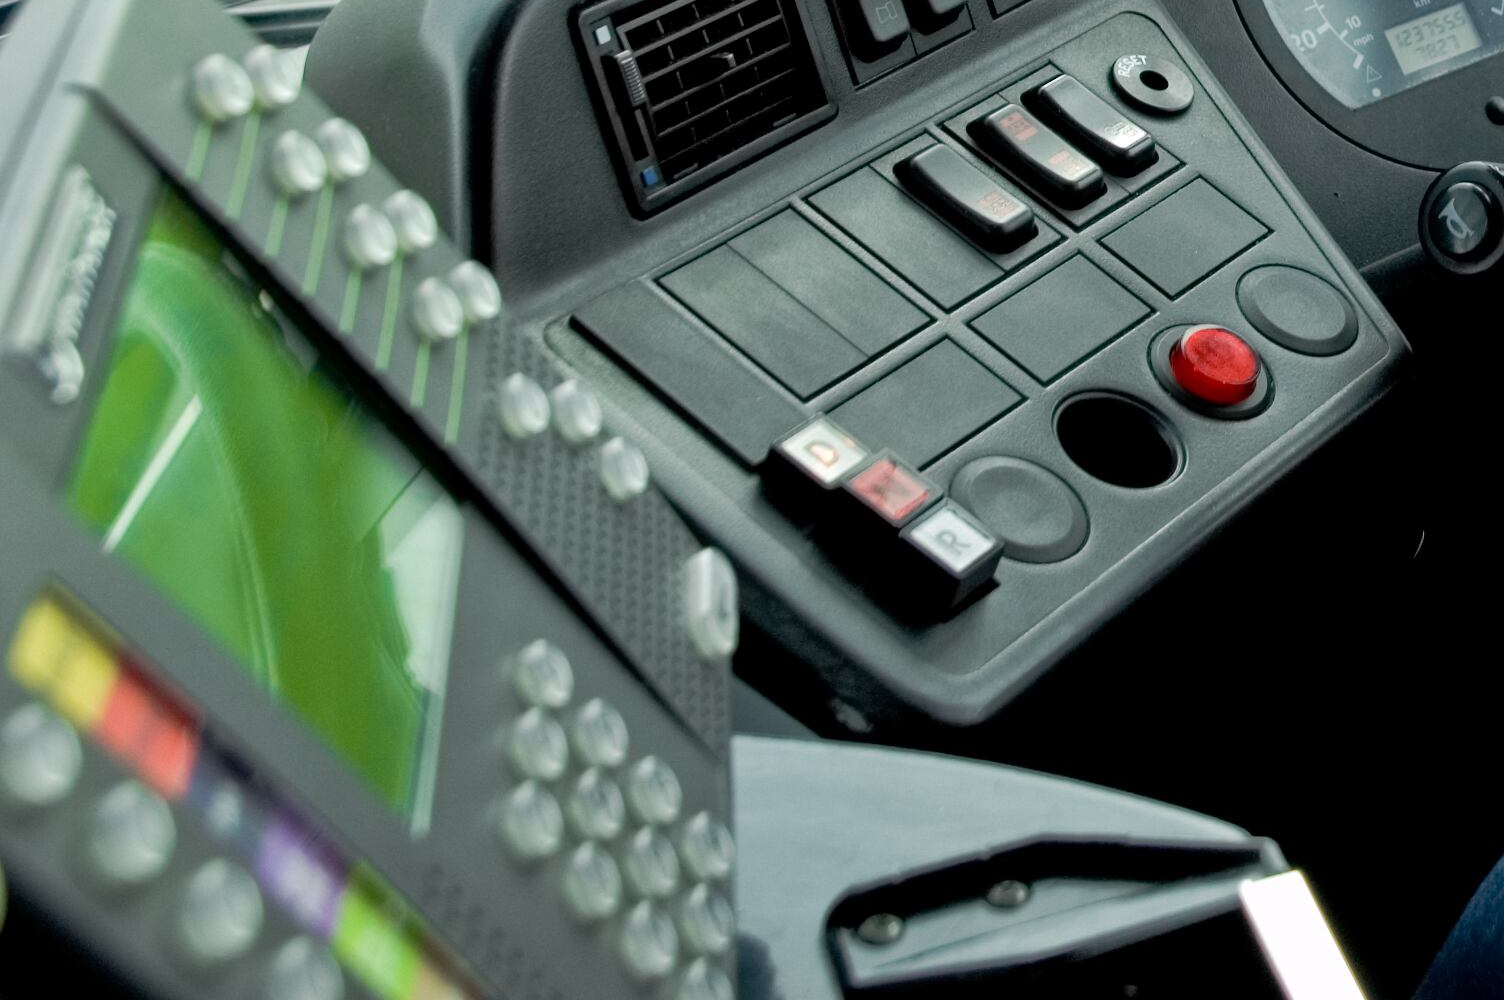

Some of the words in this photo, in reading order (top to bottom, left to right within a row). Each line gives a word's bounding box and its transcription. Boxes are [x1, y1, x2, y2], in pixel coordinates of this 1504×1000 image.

[1345, 15, 1361, 30] 10
[1290, 28, 1317, 53] 20
[1352, 33, 1374, 47] mph
[1117, 54, 1147, 79] RESET
[803, 440, 840, 468] D
[935, 529, 972, 557] R
